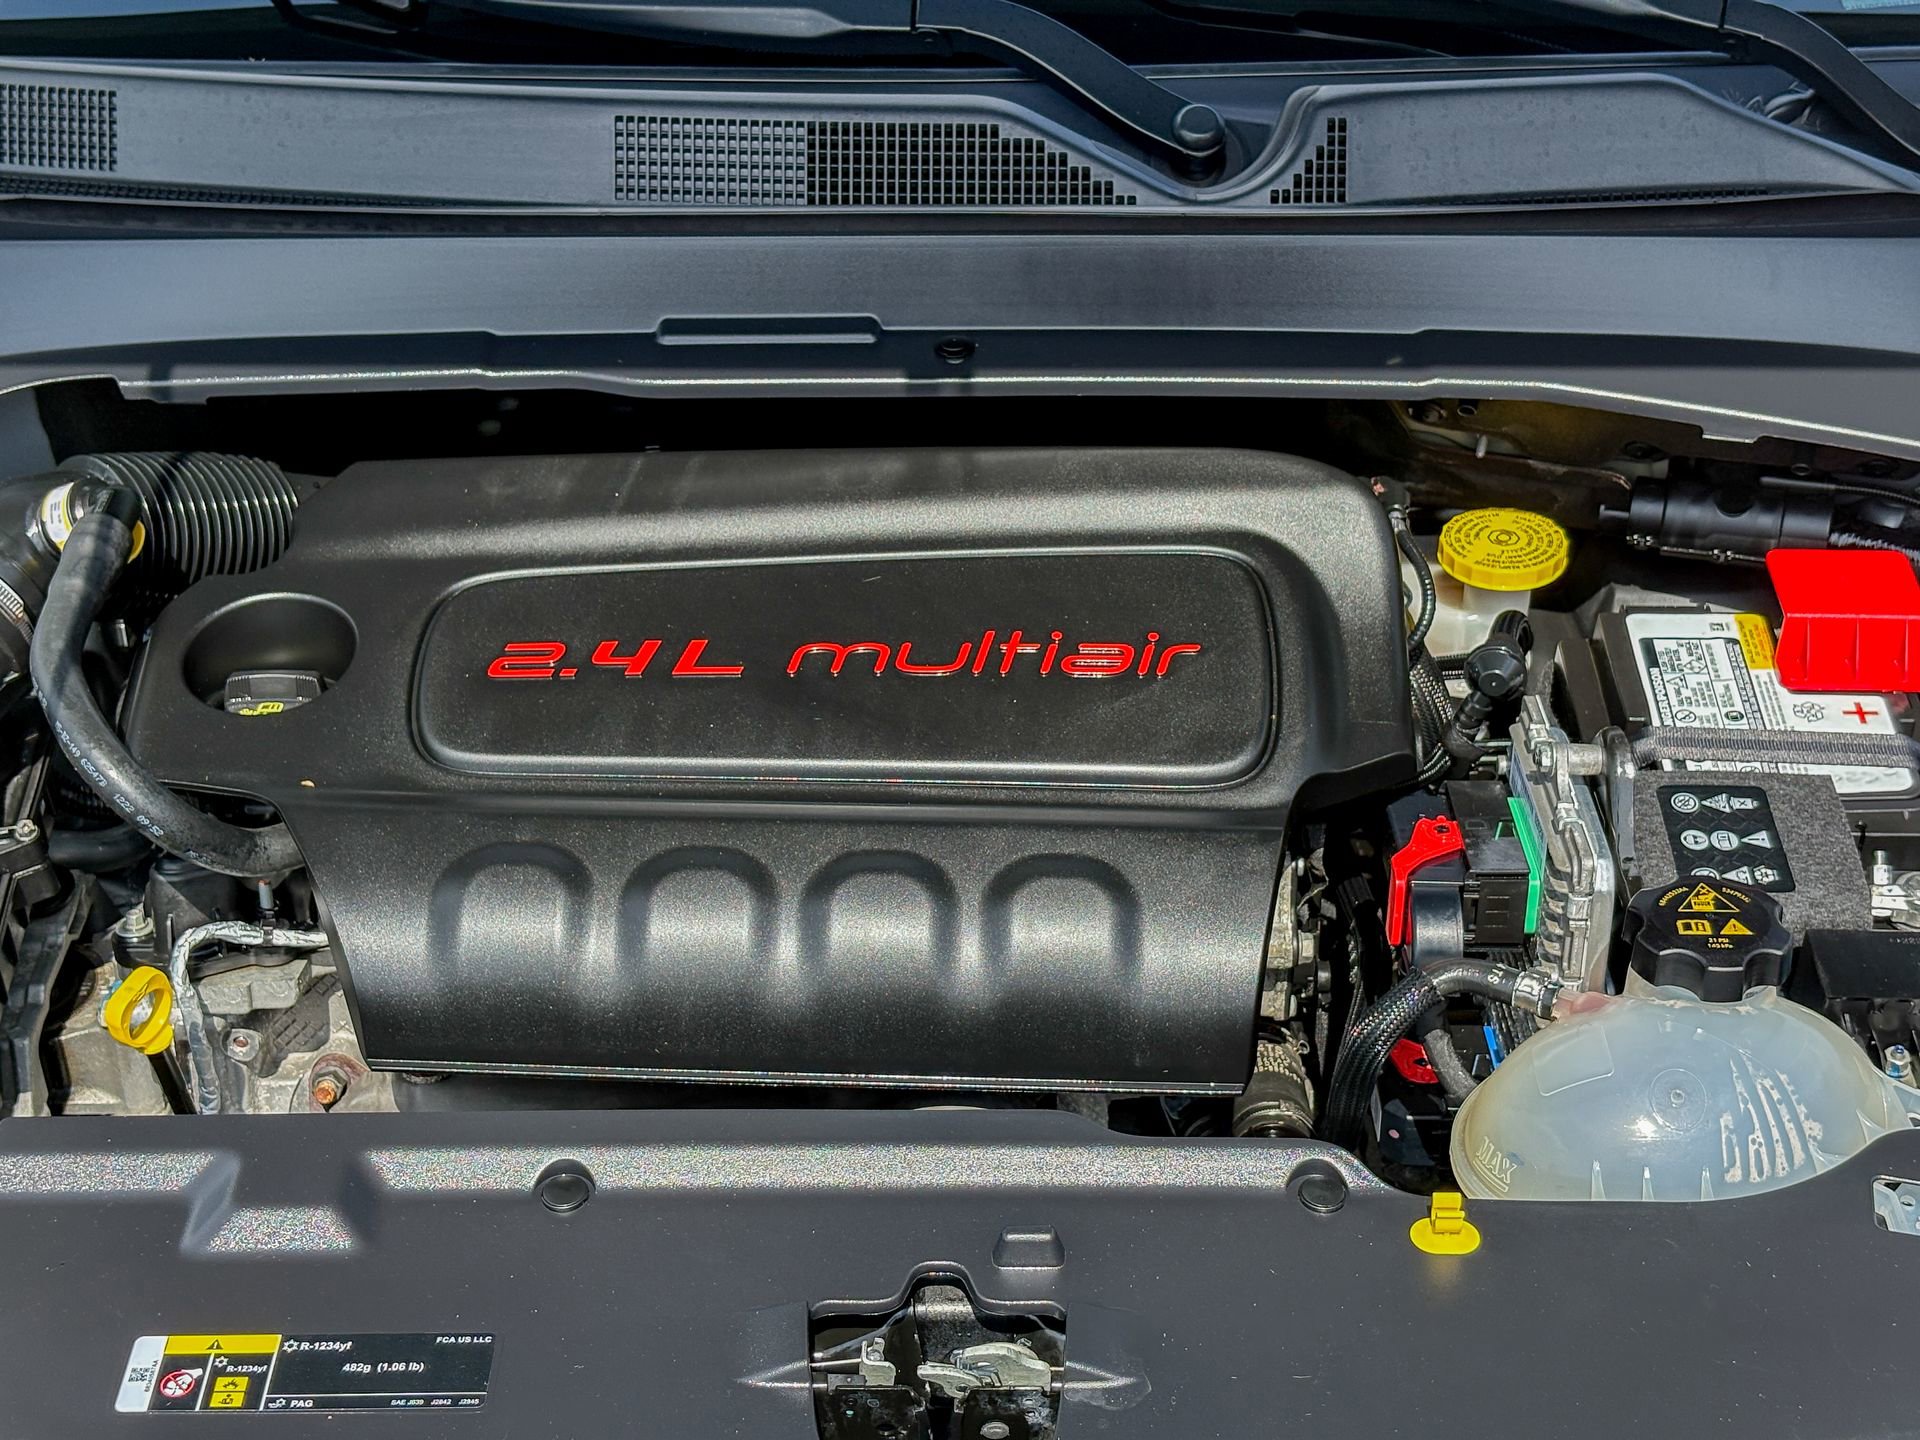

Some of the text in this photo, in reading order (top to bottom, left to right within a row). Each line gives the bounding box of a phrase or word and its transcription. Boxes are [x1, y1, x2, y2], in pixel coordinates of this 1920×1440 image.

[786, 630, 1201, 678] multiair
[1649, 667, 1668, 701] POISON
[113, 793, 135, 813] 1222
[1476, 1136, 1517, 1183] MAX
[436, 1336, 456, 1344] FCA
[300, 1341, 353, 1352] R-1234yf
[226, 1365, 268, 1374] R-1234yf
[342, 1361, 425, 1373] 482g (1.06 lb)
[290, 1399, 314, 1408] PAG
